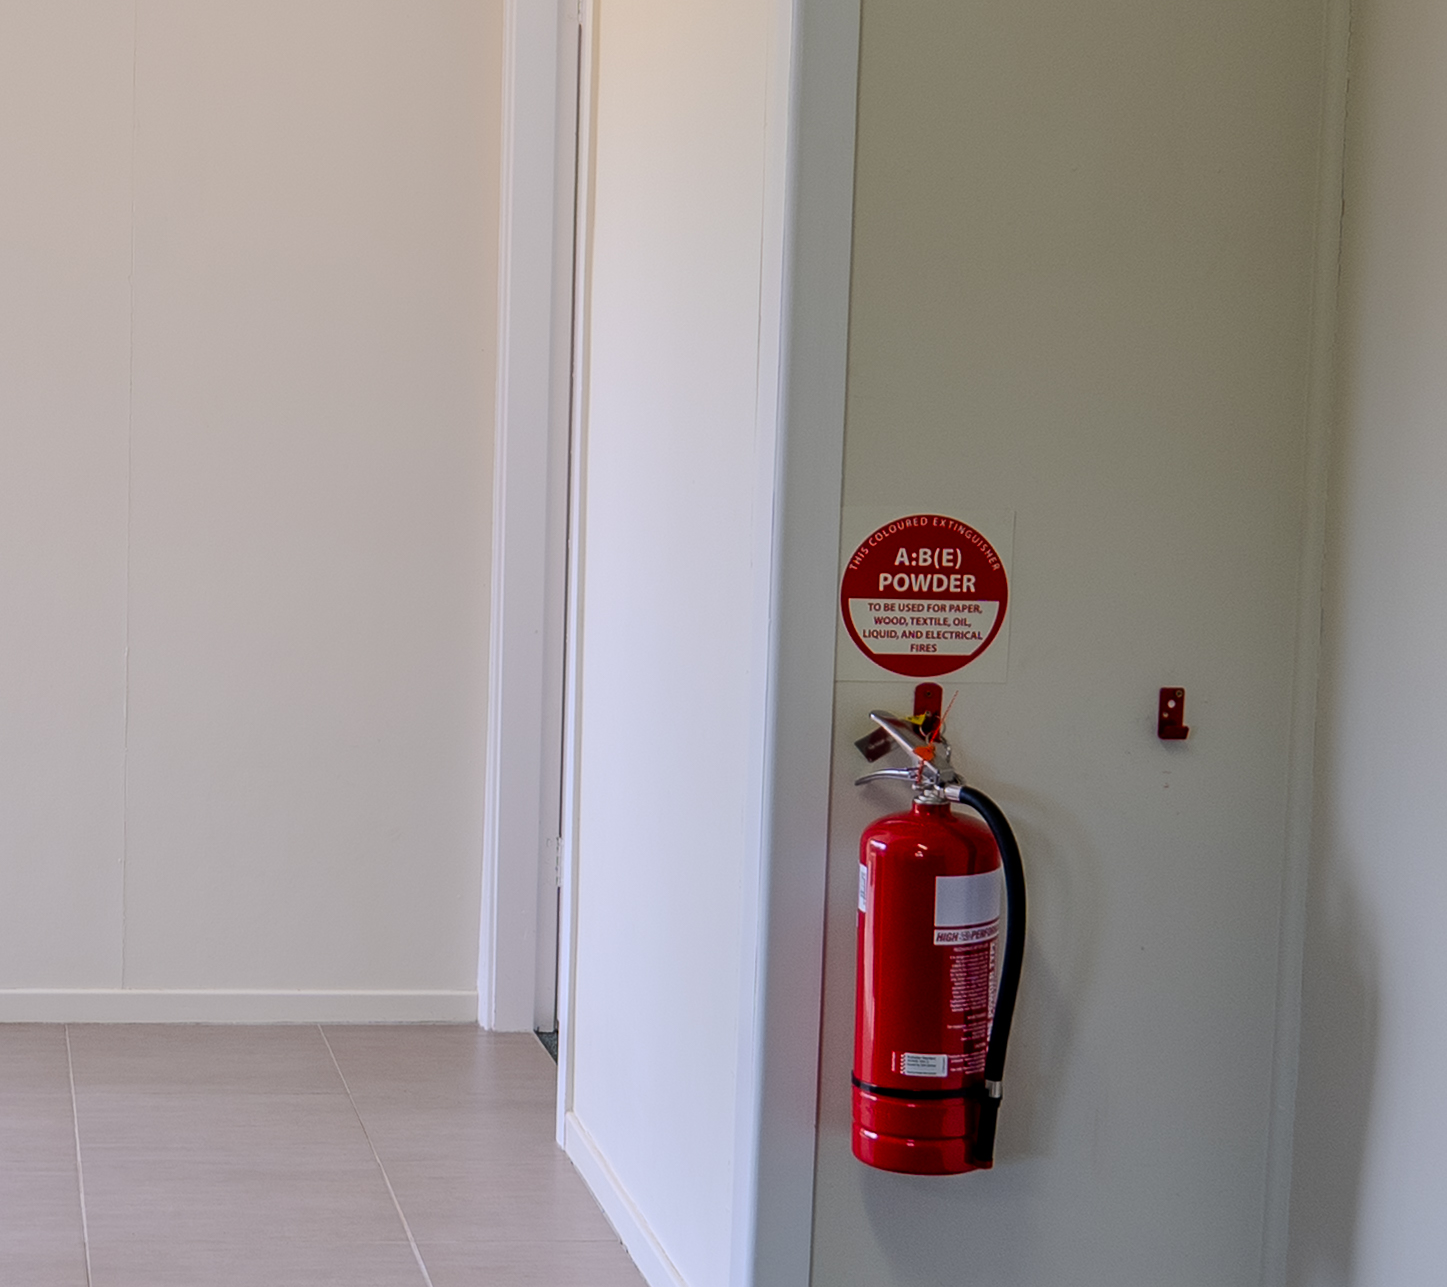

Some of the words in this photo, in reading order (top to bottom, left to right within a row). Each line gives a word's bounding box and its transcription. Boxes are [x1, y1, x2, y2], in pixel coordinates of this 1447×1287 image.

[849, 546, 869, 570] THIS
[868, 517, 928, 547] COLOURED
[932, 517, 1001, 571] EXTINGUISHER
[894, 547, 962, 569] A:B(E)
[878, 573, 976, 593] POWDER
[868, 602, 881, 612] TO
[884, 602, 896, 612] BE
[898, 603, 924, 613] USED
[926, 603, 947, 613] FOR
[949, 604, 983, 614] PAPER,
[874, 616, 909, 627] WOOD,
[910, 616, 951, 627] TEXTILE,
[952, 617, 972, 628] OIL,
[862, 629, 900, 640] LIQUID,
[901, 630, 923, 640] AND
[925, 630, 983, 640] ELECTRICAL
[910, 643, 937, 653] FIRES
[936, 932, 959, 942] HIGH
